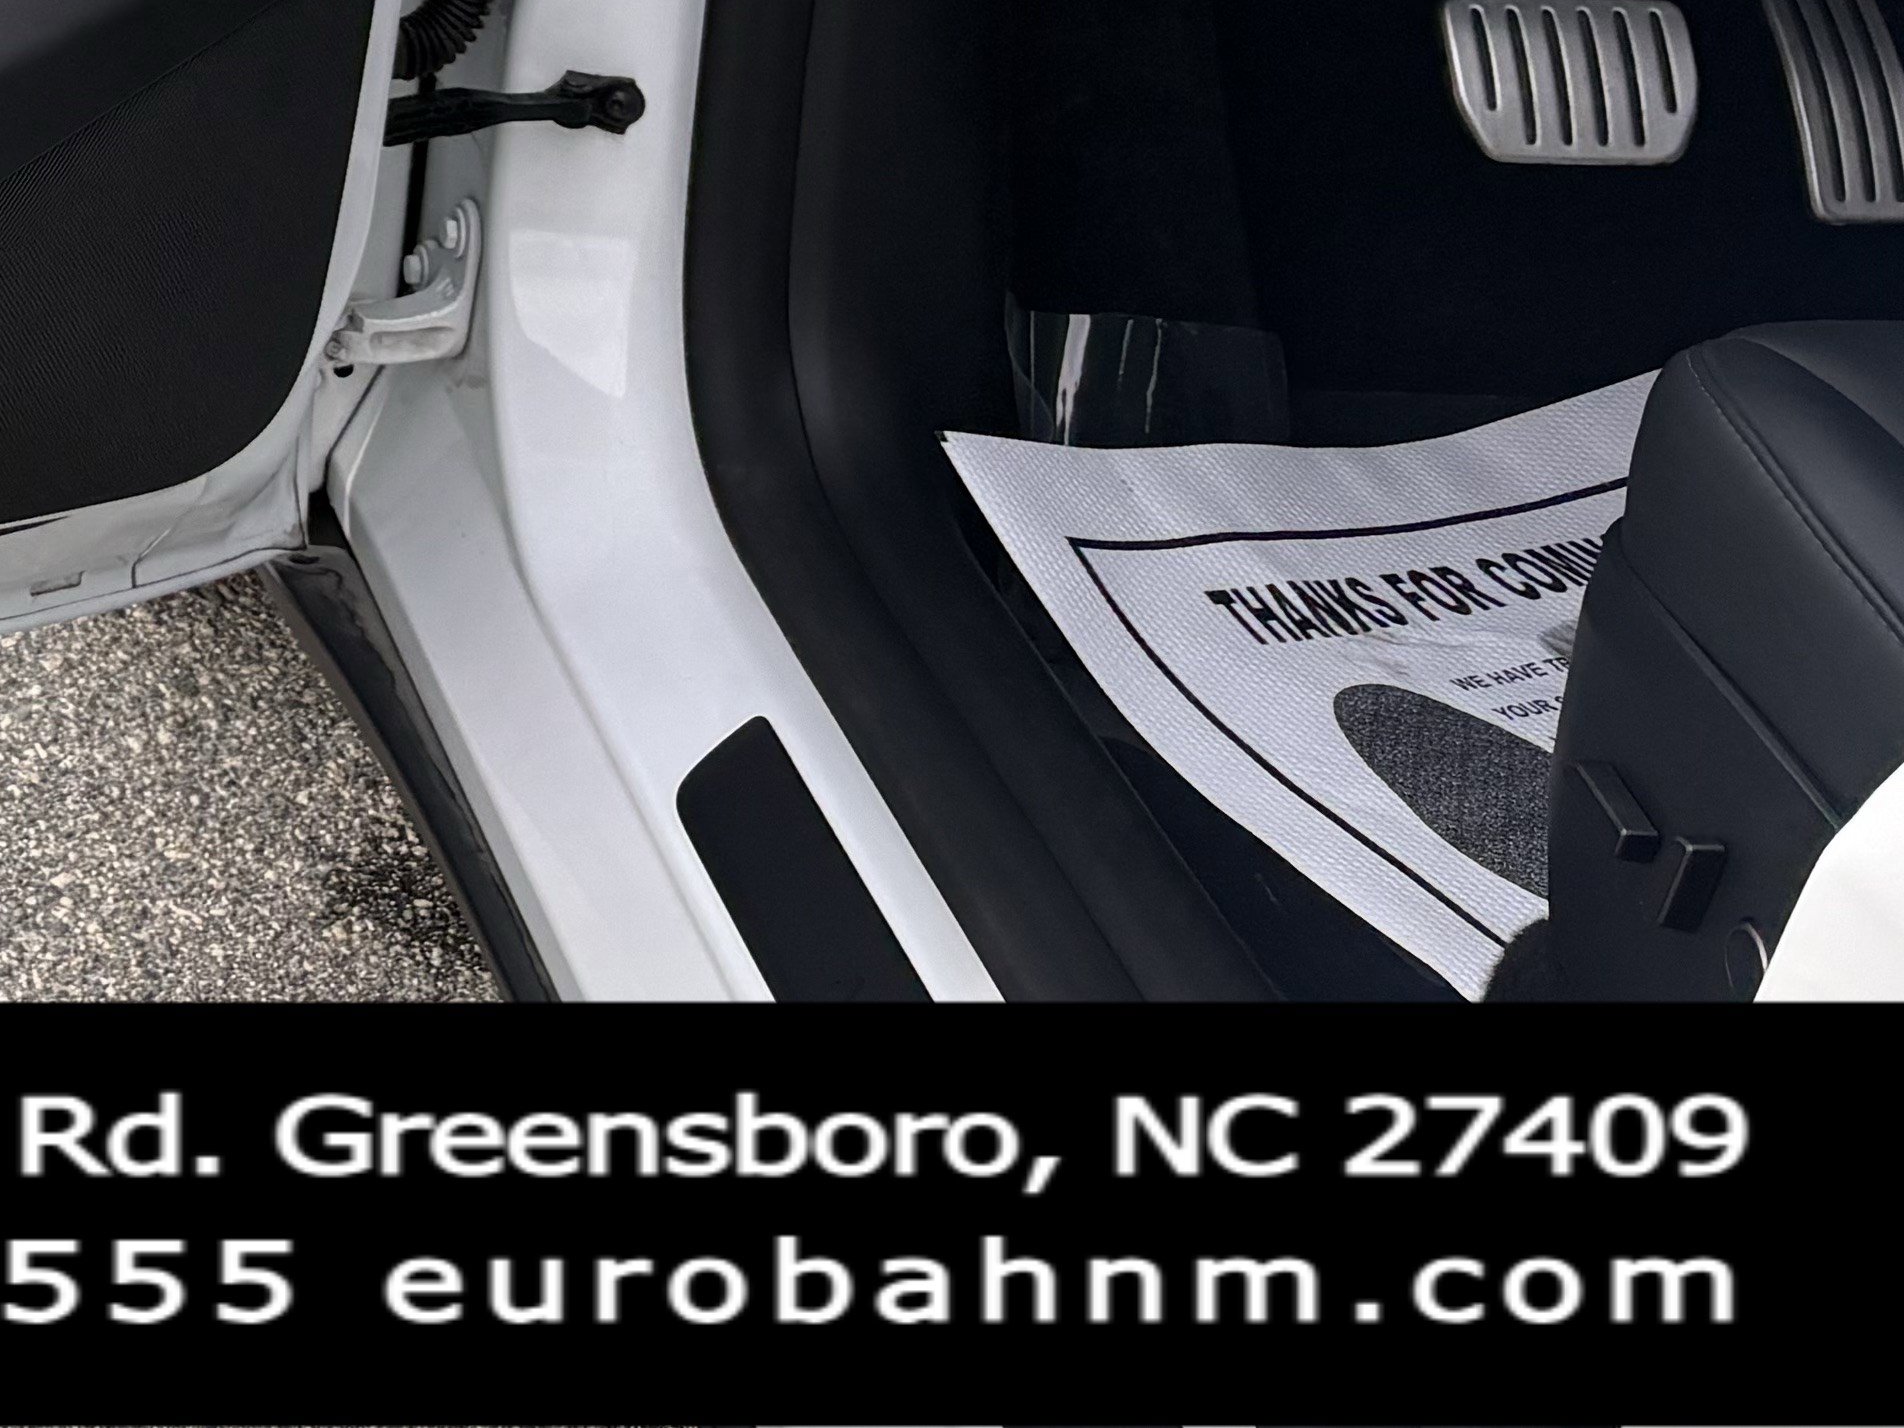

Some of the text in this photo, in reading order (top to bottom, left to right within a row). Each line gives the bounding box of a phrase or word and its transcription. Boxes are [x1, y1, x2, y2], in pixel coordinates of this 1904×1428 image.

[1204, 576, 1409, 645] THANKS
[1379, 565, 1505, 623] FOR
[1449, 675, 1492, 691] WE
[1486, 662, 1549, 685] HAVE
[1491, 699, 1559, 721] YOUR
